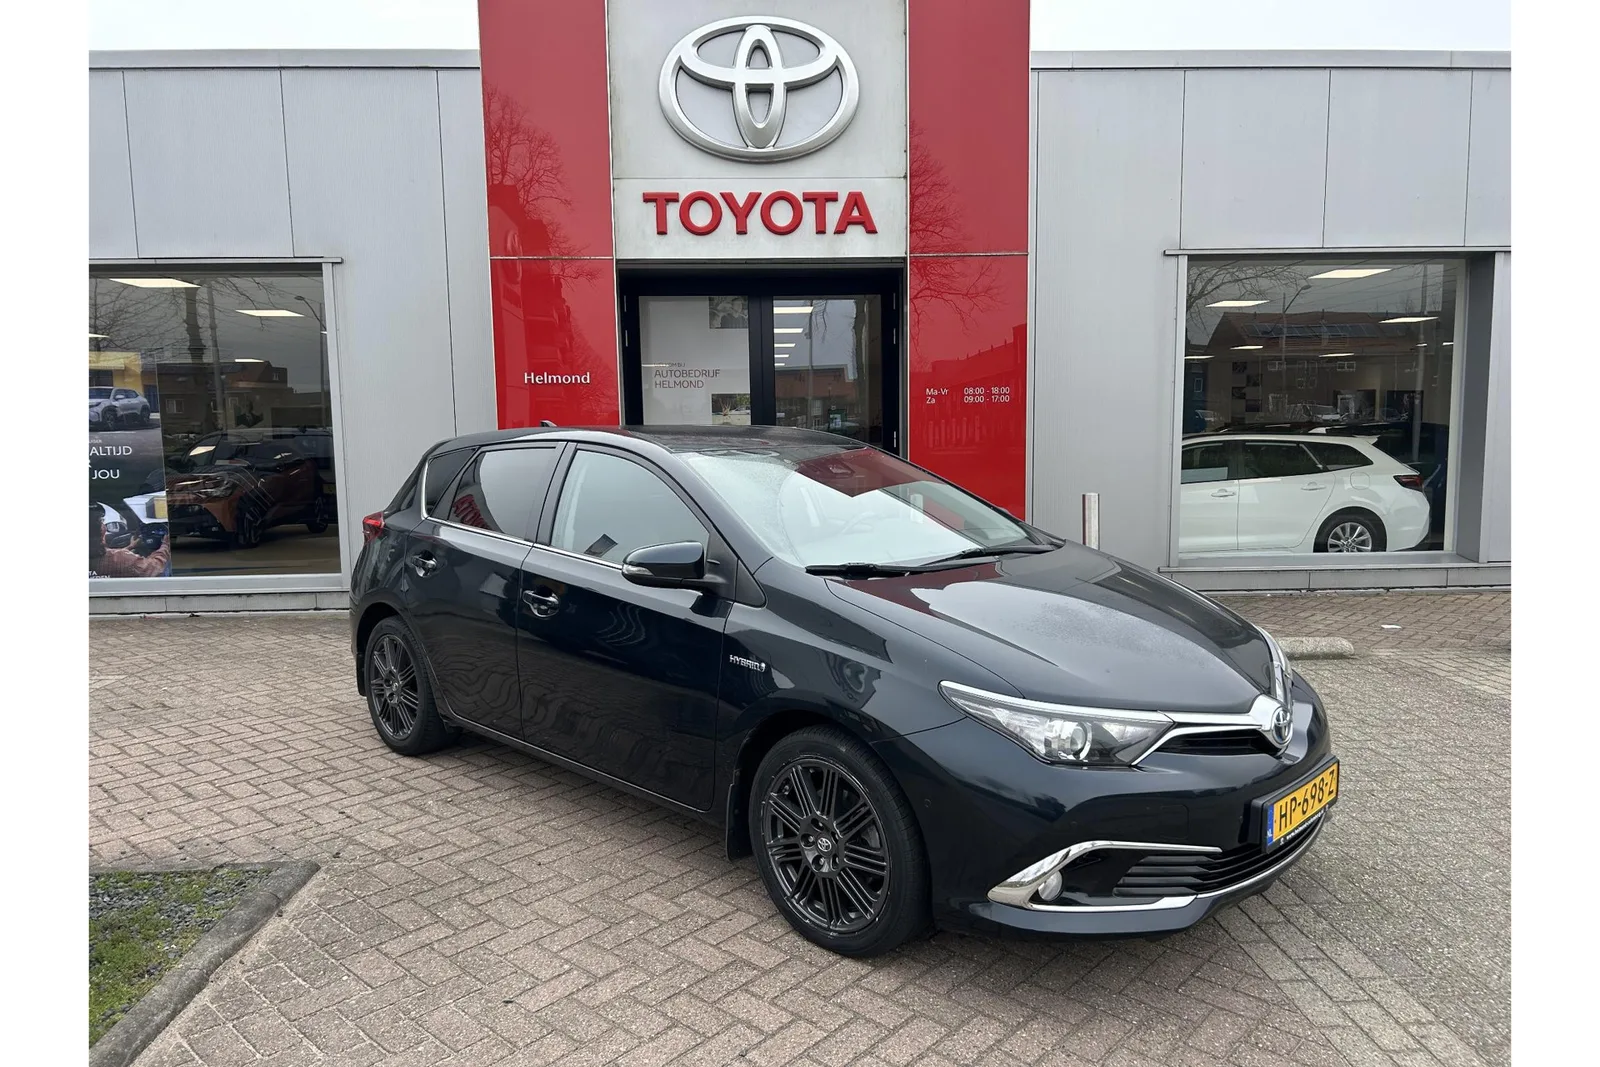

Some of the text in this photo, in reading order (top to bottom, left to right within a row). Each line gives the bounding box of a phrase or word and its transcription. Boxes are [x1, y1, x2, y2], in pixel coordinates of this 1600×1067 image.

[643, 190, 878, 236] TOYOTA
[524, 371, 590, 384] Helmond
[654, 369, 721, 379] AUTOBEDRIJF
[654, 380, 704, 389] HELMOND
[925, 388, 949, 396] Ma-Vr
[963, 387, 985, 395] 08:00
[991, 386, 1010, 394] 18:00
[926, 396, 936, 404] Za
[963, 395, 985, 403] 09:00
[991, 395, 1010, 403] 17:00
[89, 445, 132, 456] ALTIJD
[92, 469, 120, 480] JOU
[729, 654, 761, 671] HYBRID
[1279, 769, 1335, 832] HP-698-Z
